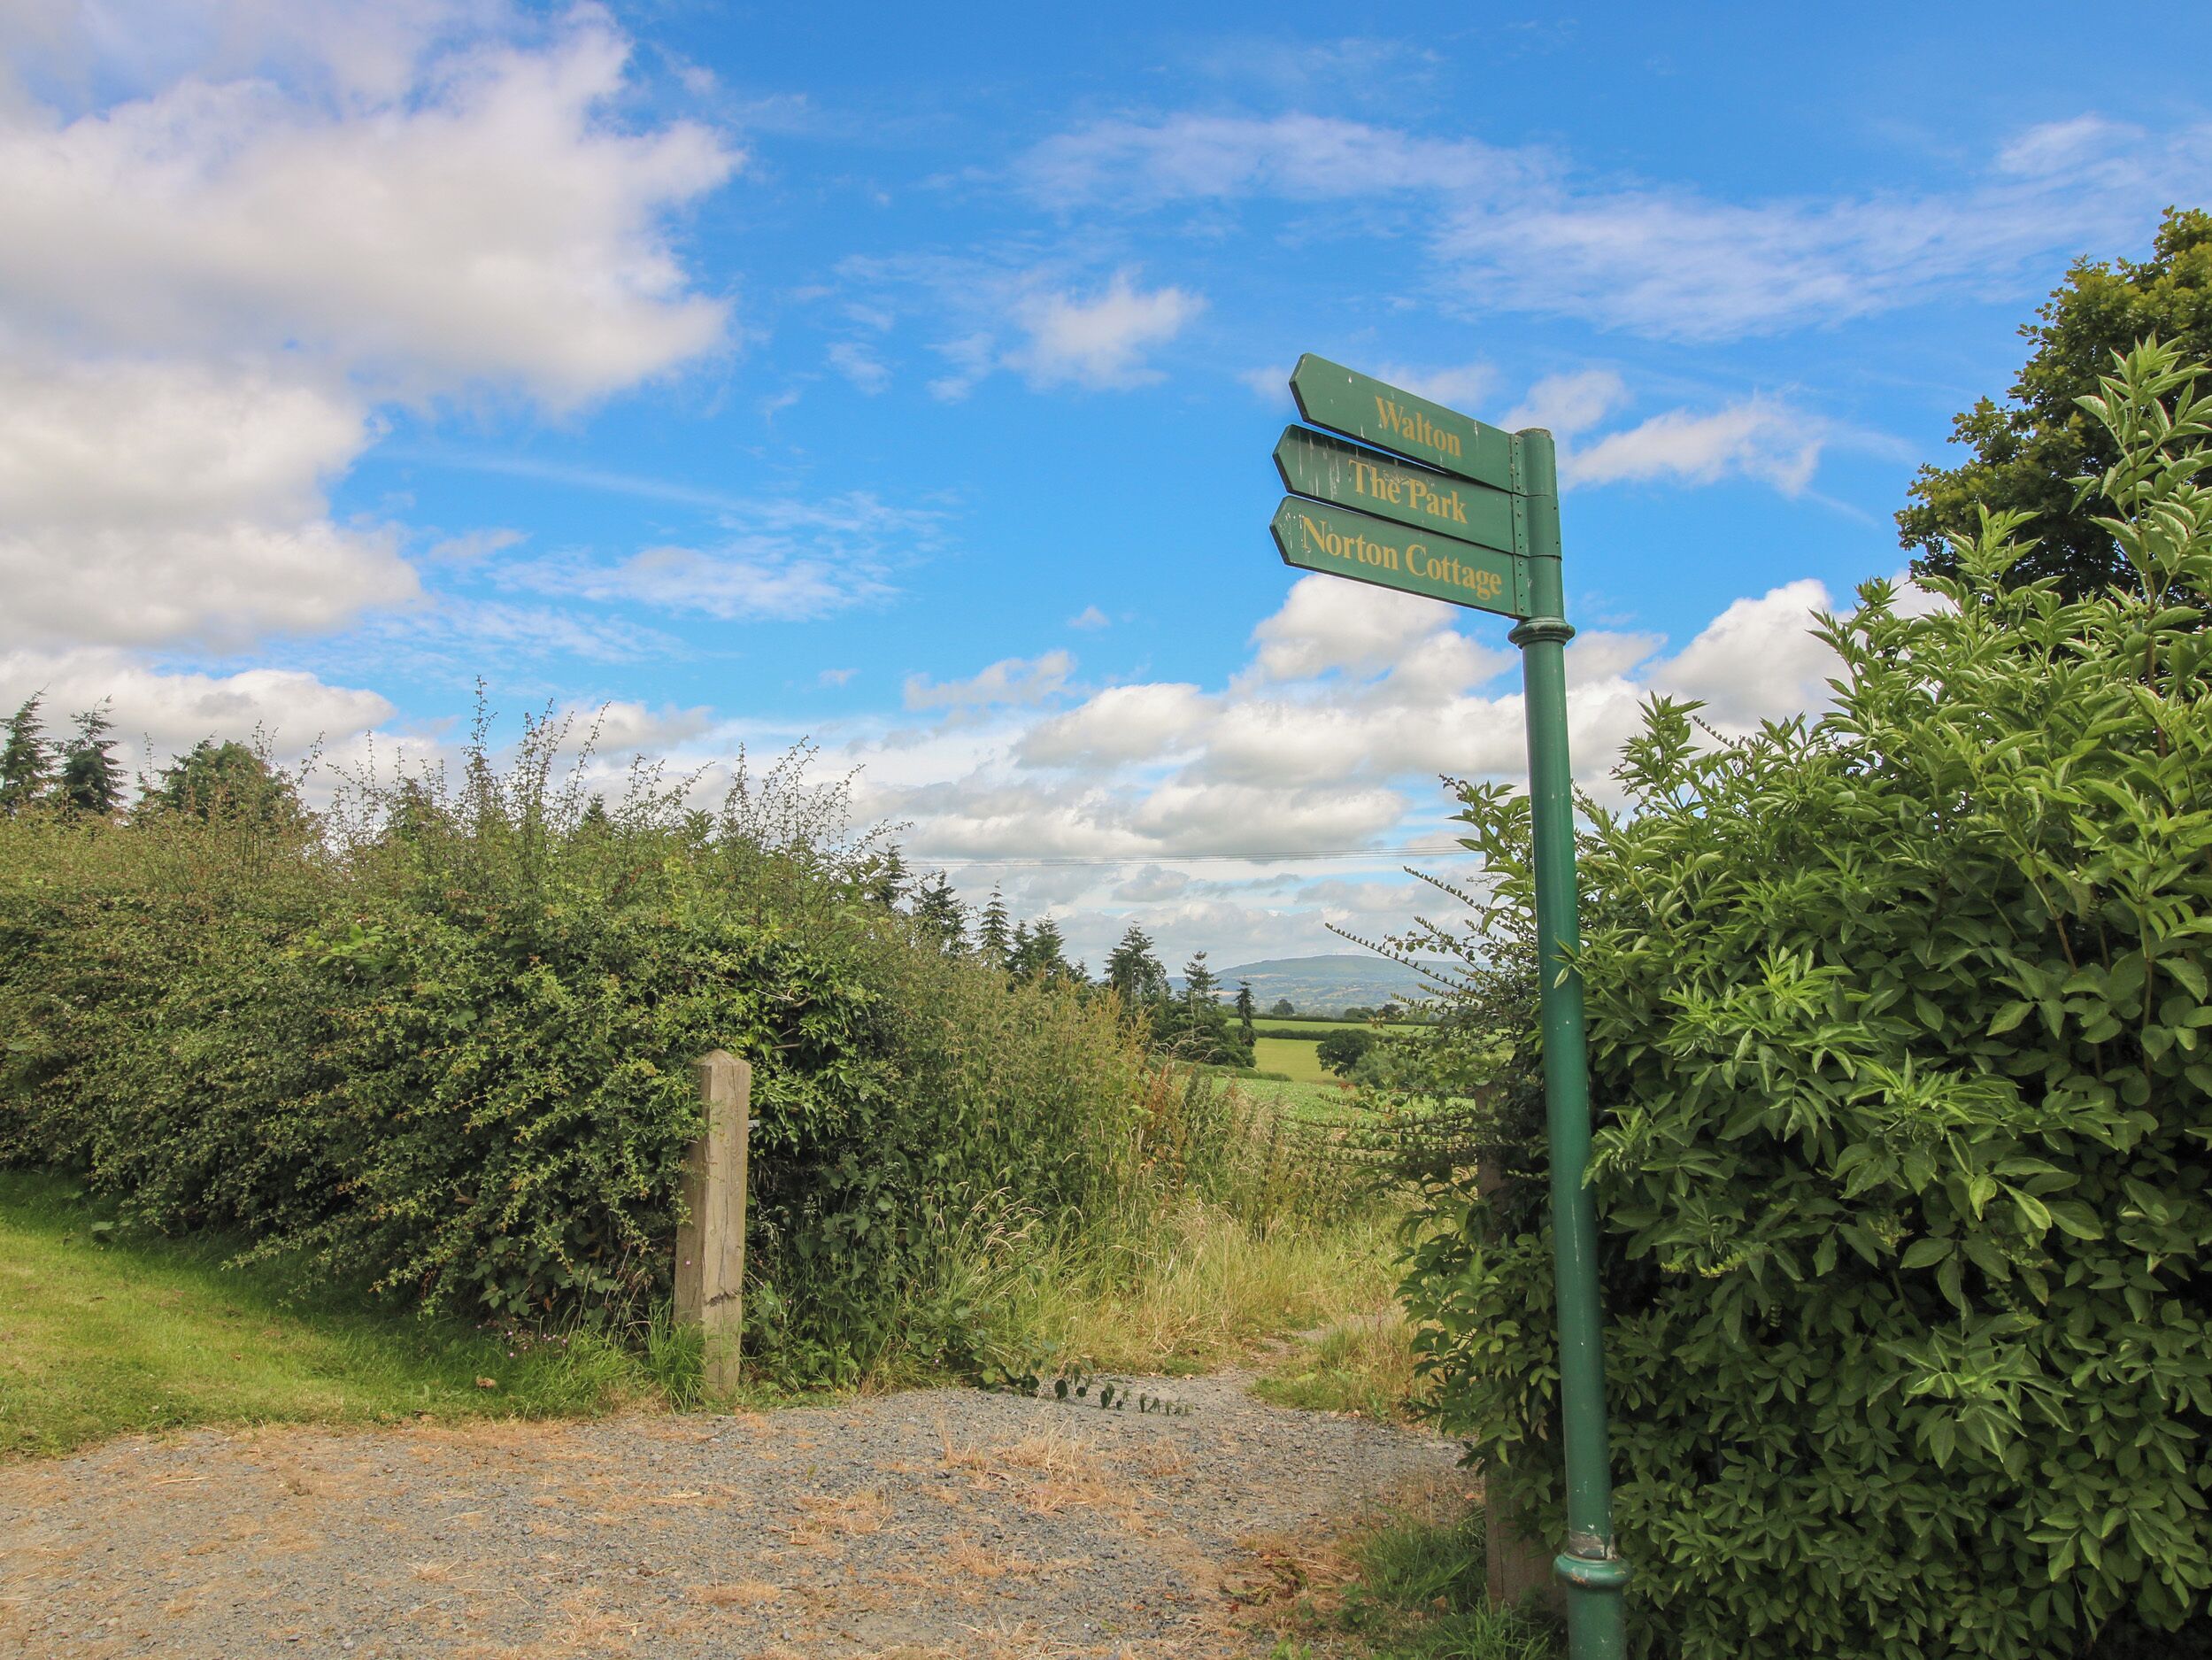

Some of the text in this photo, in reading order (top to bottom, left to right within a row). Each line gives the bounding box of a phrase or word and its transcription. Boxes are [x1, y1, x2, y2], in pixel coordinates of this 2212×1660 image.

[1376, 396, 1461, 457] Walton
[1348, 459, 1468, 524] The Park
[1302, 516, 1502, 600] Norton Cottage
